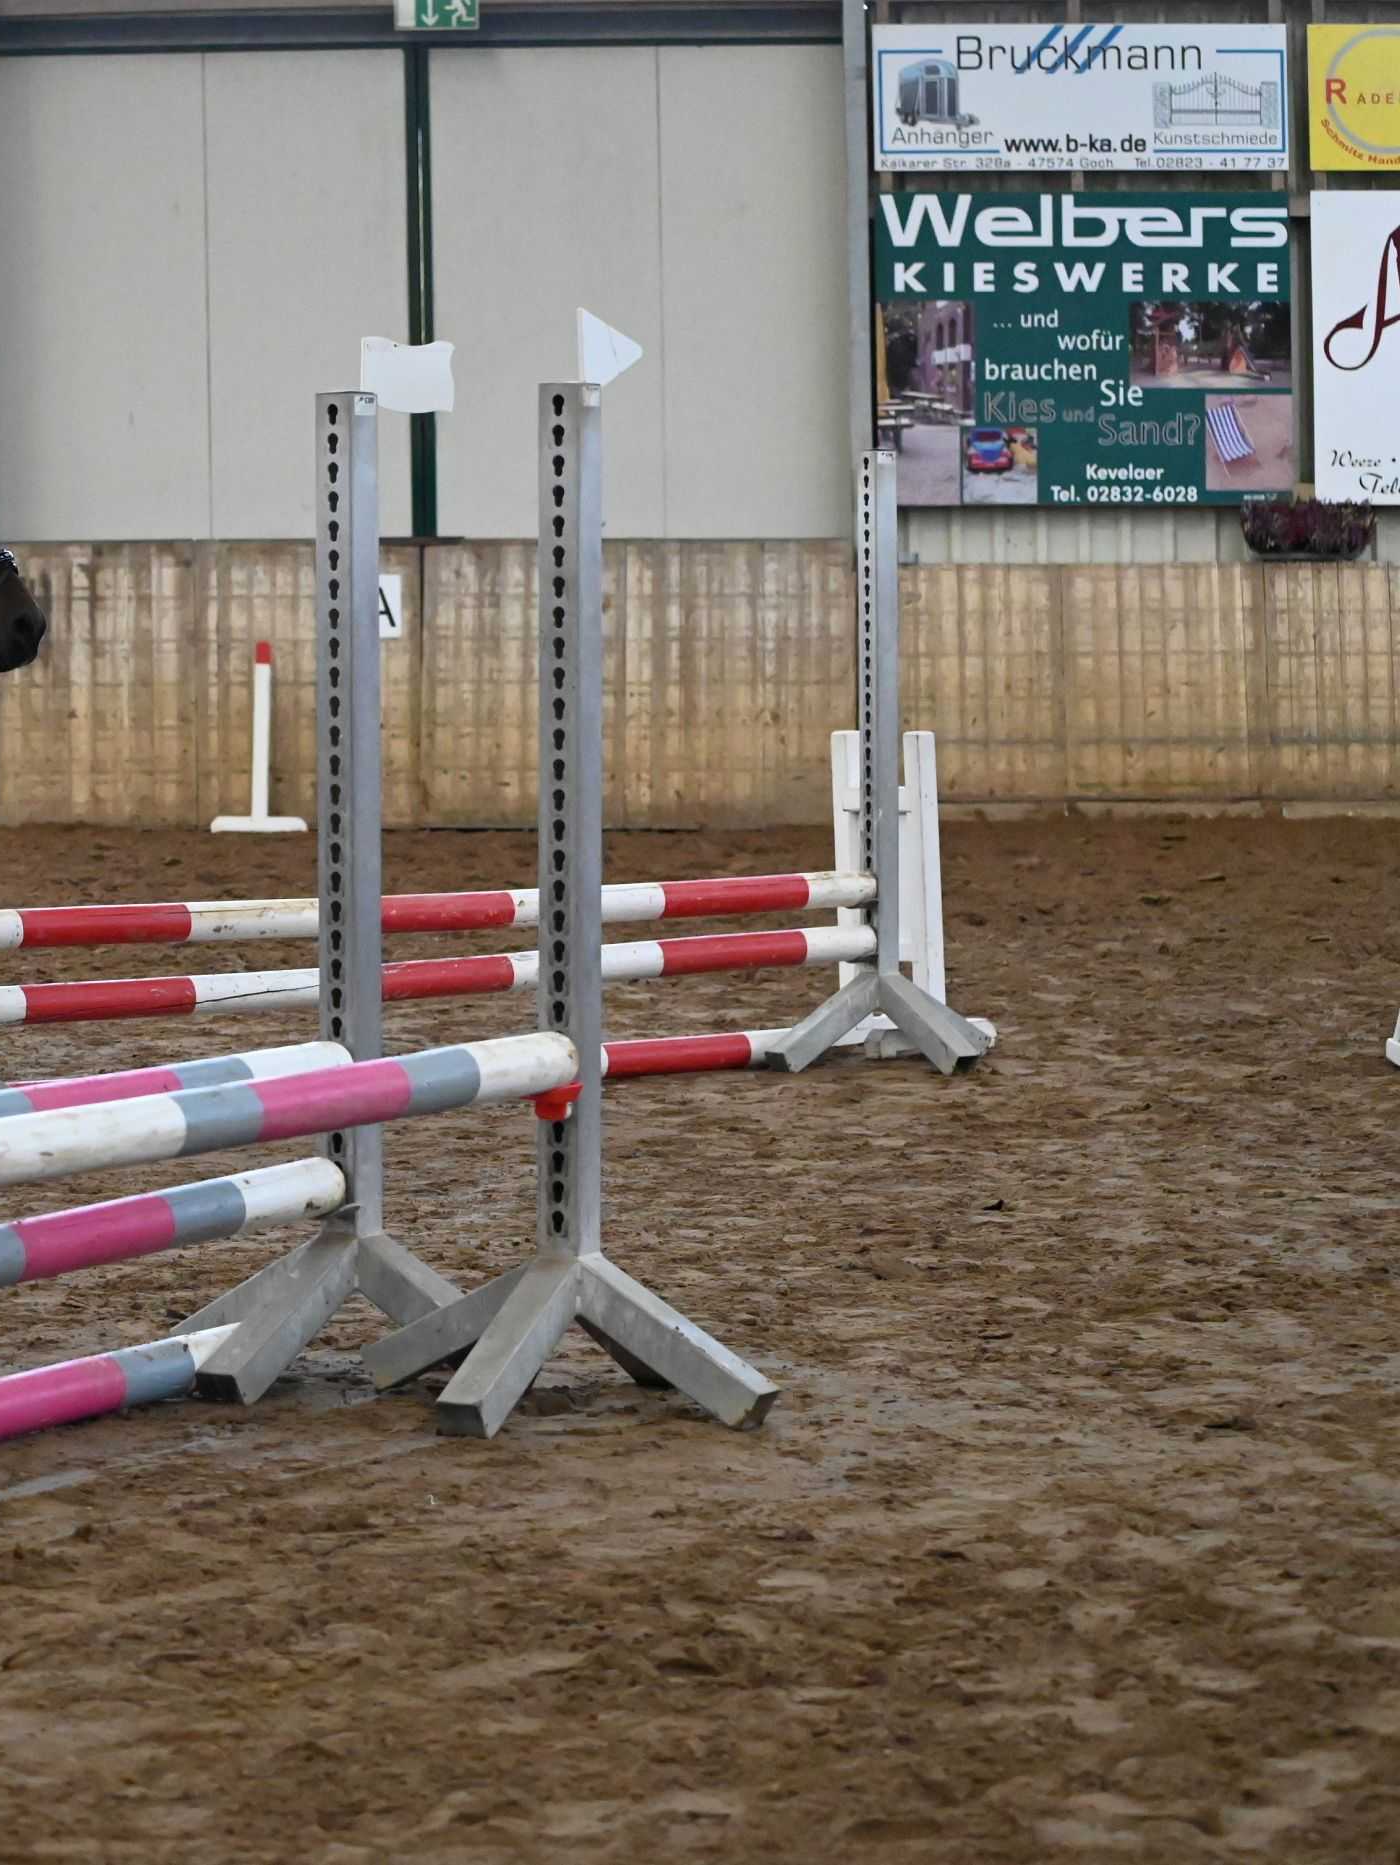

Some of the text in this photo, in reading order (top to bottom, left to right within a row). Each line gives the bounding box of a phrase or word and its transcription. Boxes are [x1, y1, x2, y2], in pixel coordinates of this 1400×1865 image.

[955, 34, 1203, 72] Bruckmann
[1004, 133, 1147, 153] www.b-ka.de
[1153, 131, 1278, 146] Kunstschmiede
[880, 157, 937, 169] Kalkarer
[1027, 158, 1074, 169] 47574
[1245, 157, 1261, 169] 77
[879, 193, 1289, 248] Welbers
[893, 261, 1280, 294] KIESWERKE
[1020, 309, 1059, 329] und
[1057, 329, 1125, 352] wofür
[984, 358, 1098, 381] brauchen
[1099, 379, 1144, 408] Sie
[983, 391, 1095, 424] Kies und
[1098, 412, 1201, 447] Sand?
[1330, 449, 1382, 467] Weeze
[1085, 464, 1165, 481] Kevelaer
[1359, 472, 1400, 496] Tel
[1051, 485, 1198, 503] Tel. 02832-6028
